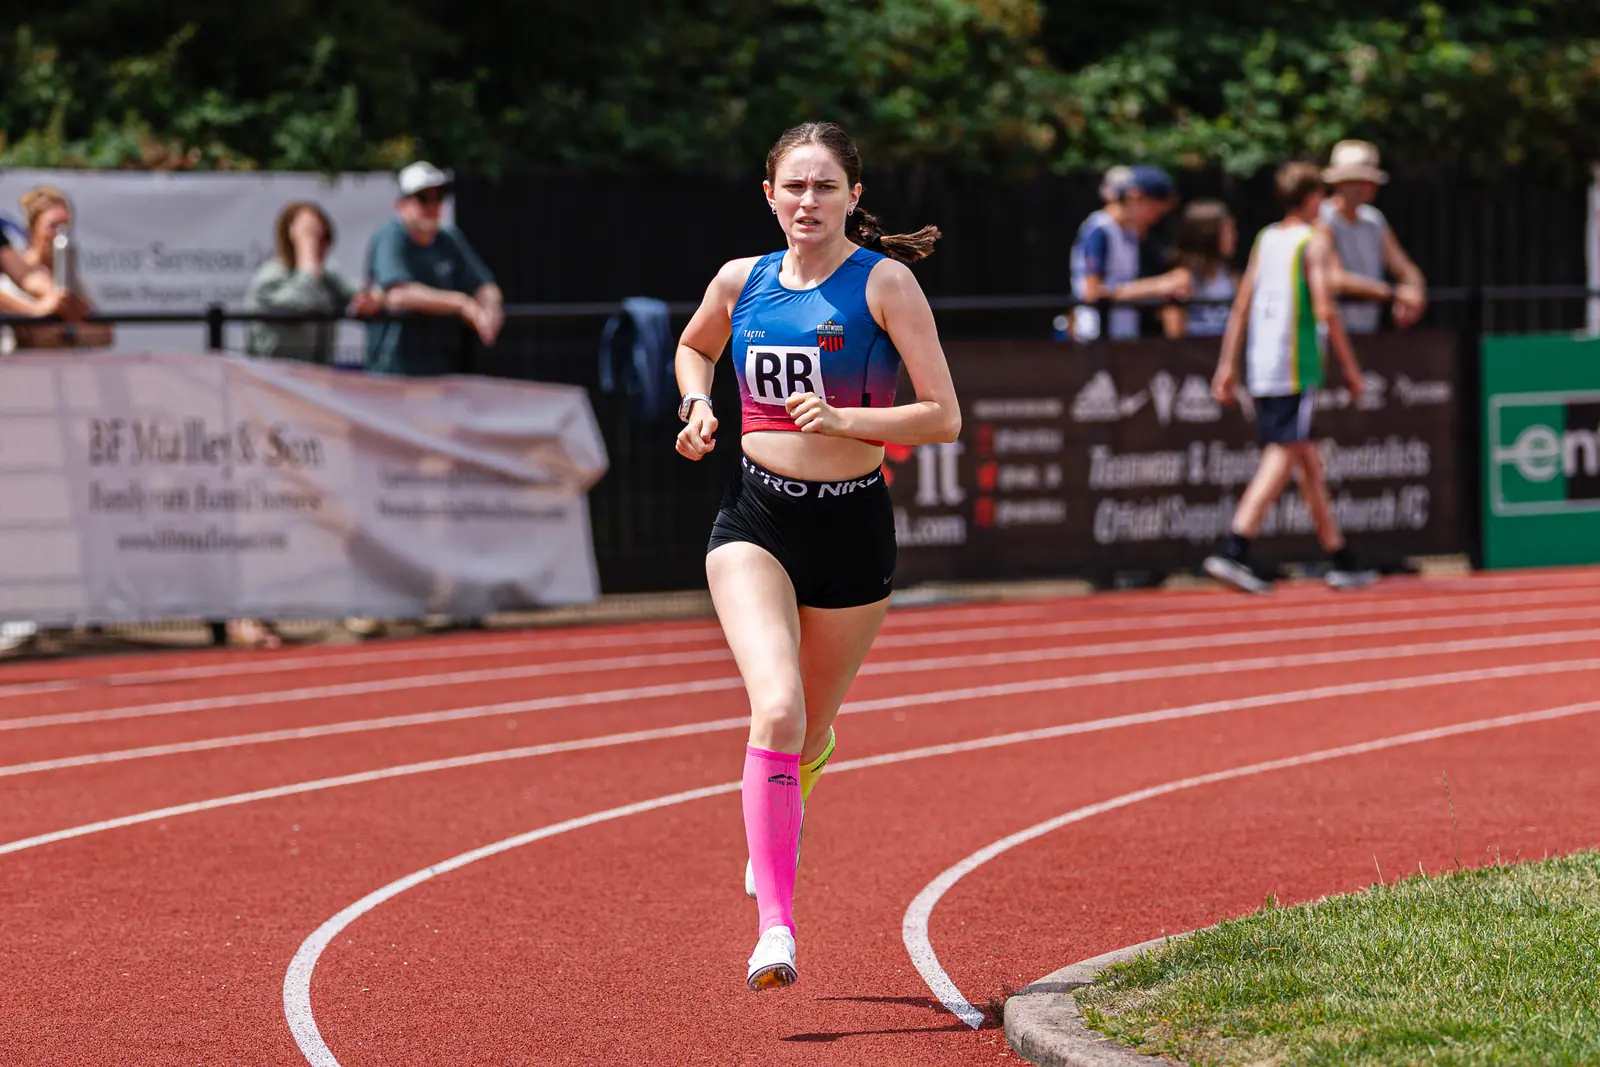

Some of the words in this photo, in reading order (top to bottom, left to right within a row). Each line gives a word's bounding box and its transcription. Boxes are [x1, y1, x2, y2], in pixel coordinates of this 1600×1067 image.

[743, 329, 766, 338] TACTIC
[755, 352, 815, 398] RR
[262, 420, 327, 468] Son
[1089, 444, 1186, 488] Teamwear
[1498, 420, 1600, 483] en
